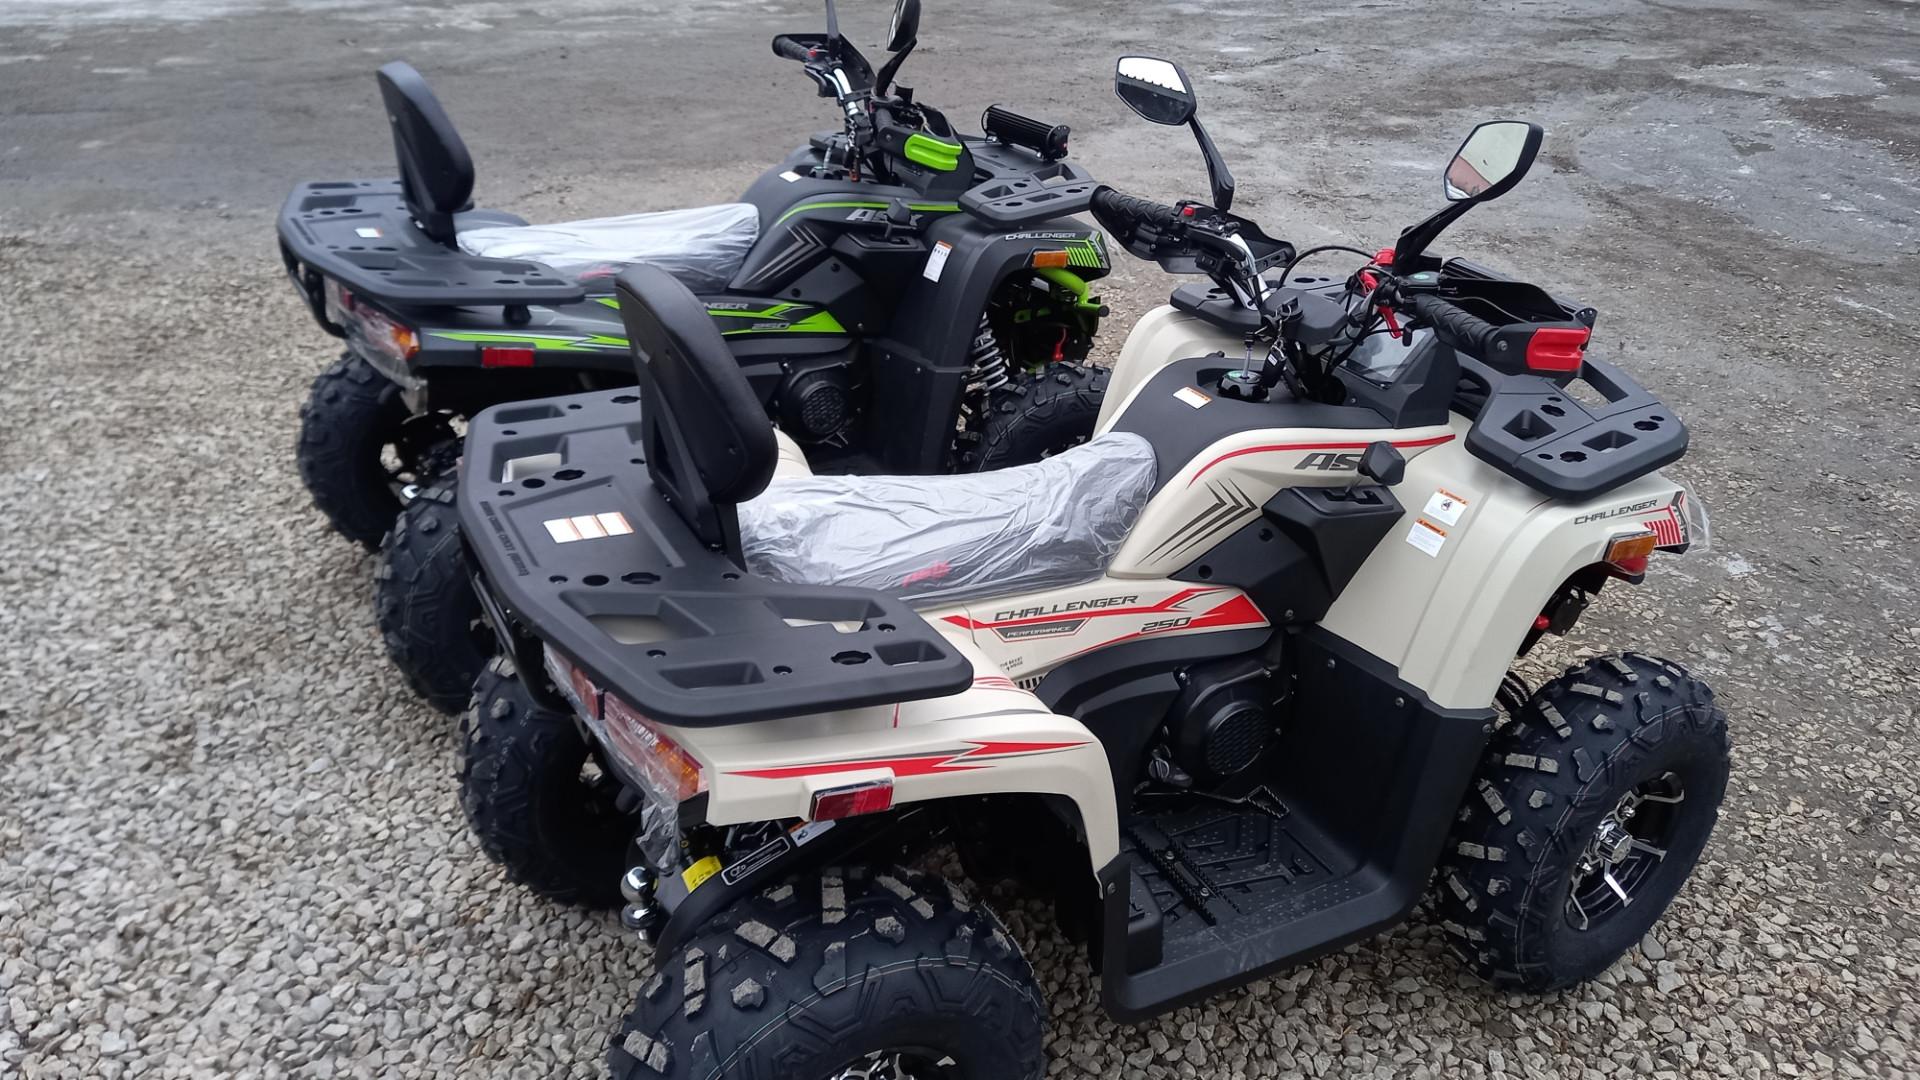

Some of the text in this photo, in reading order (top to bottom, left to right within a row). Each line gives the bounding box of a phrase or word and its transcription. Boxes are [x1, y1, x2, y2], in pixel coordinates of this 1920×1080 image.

[1005, 232, 1077, 241] CHALLENGER
[1293, 452, 1363, 471] AS
[1574, 499, 1658, 525] CHALLENGER
[994, 595, 1138, 622] CHALLENGER
[1006, 626, 1073, 638] PERFORMANCE
[1141, 616, 1192, 632] 250
